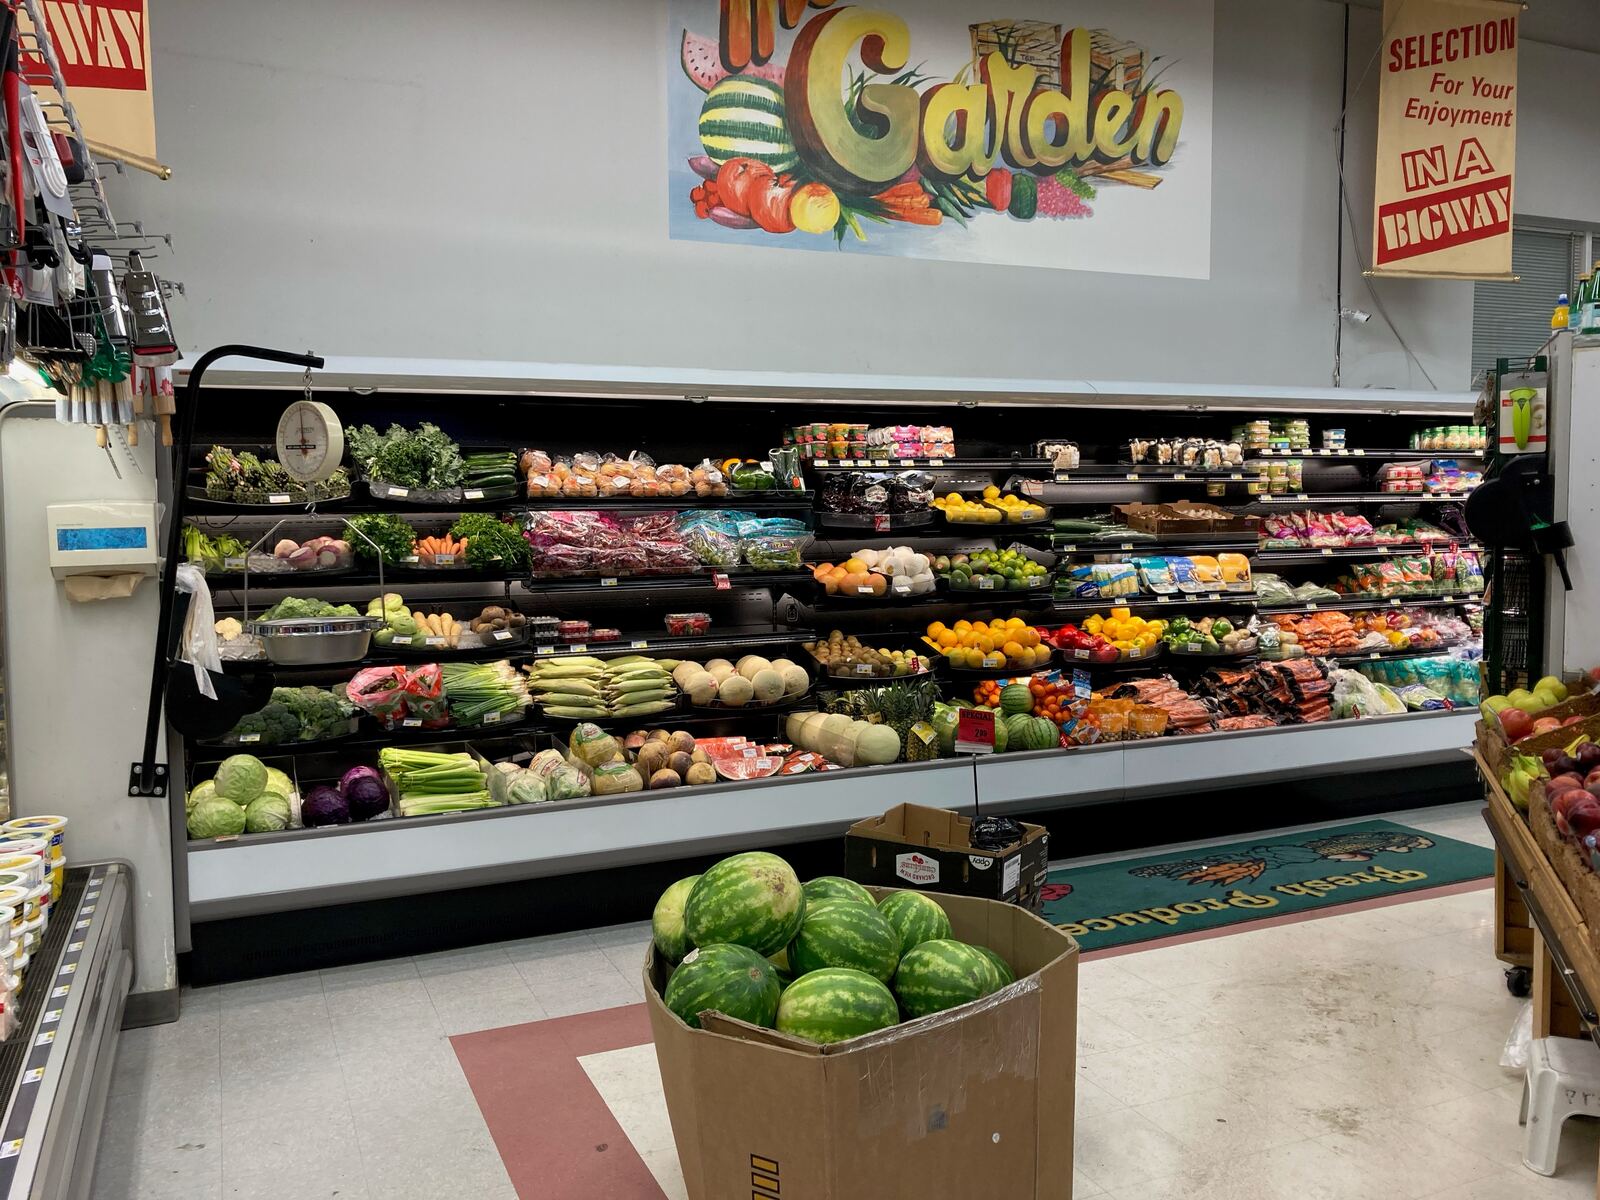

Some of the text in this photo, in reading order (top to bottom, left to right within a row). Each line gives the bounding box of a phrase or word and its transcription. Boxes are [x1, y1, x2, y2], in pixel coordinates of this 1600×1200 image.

[1388, 16, 1516, 73] SELECTION
[783, 4, 1184, 196] Garden
[1404, 97, 1514, 128] Enjoyment
[1429, 73, 1514, 100] For Your
[1401, 137, 1495, 193] IN A
[1381, 186, 1509, 251] BIGWAY
[960, 710, 992, 721] SPECIAL
[1060, 865, 1428, 936] Fresh Produce
